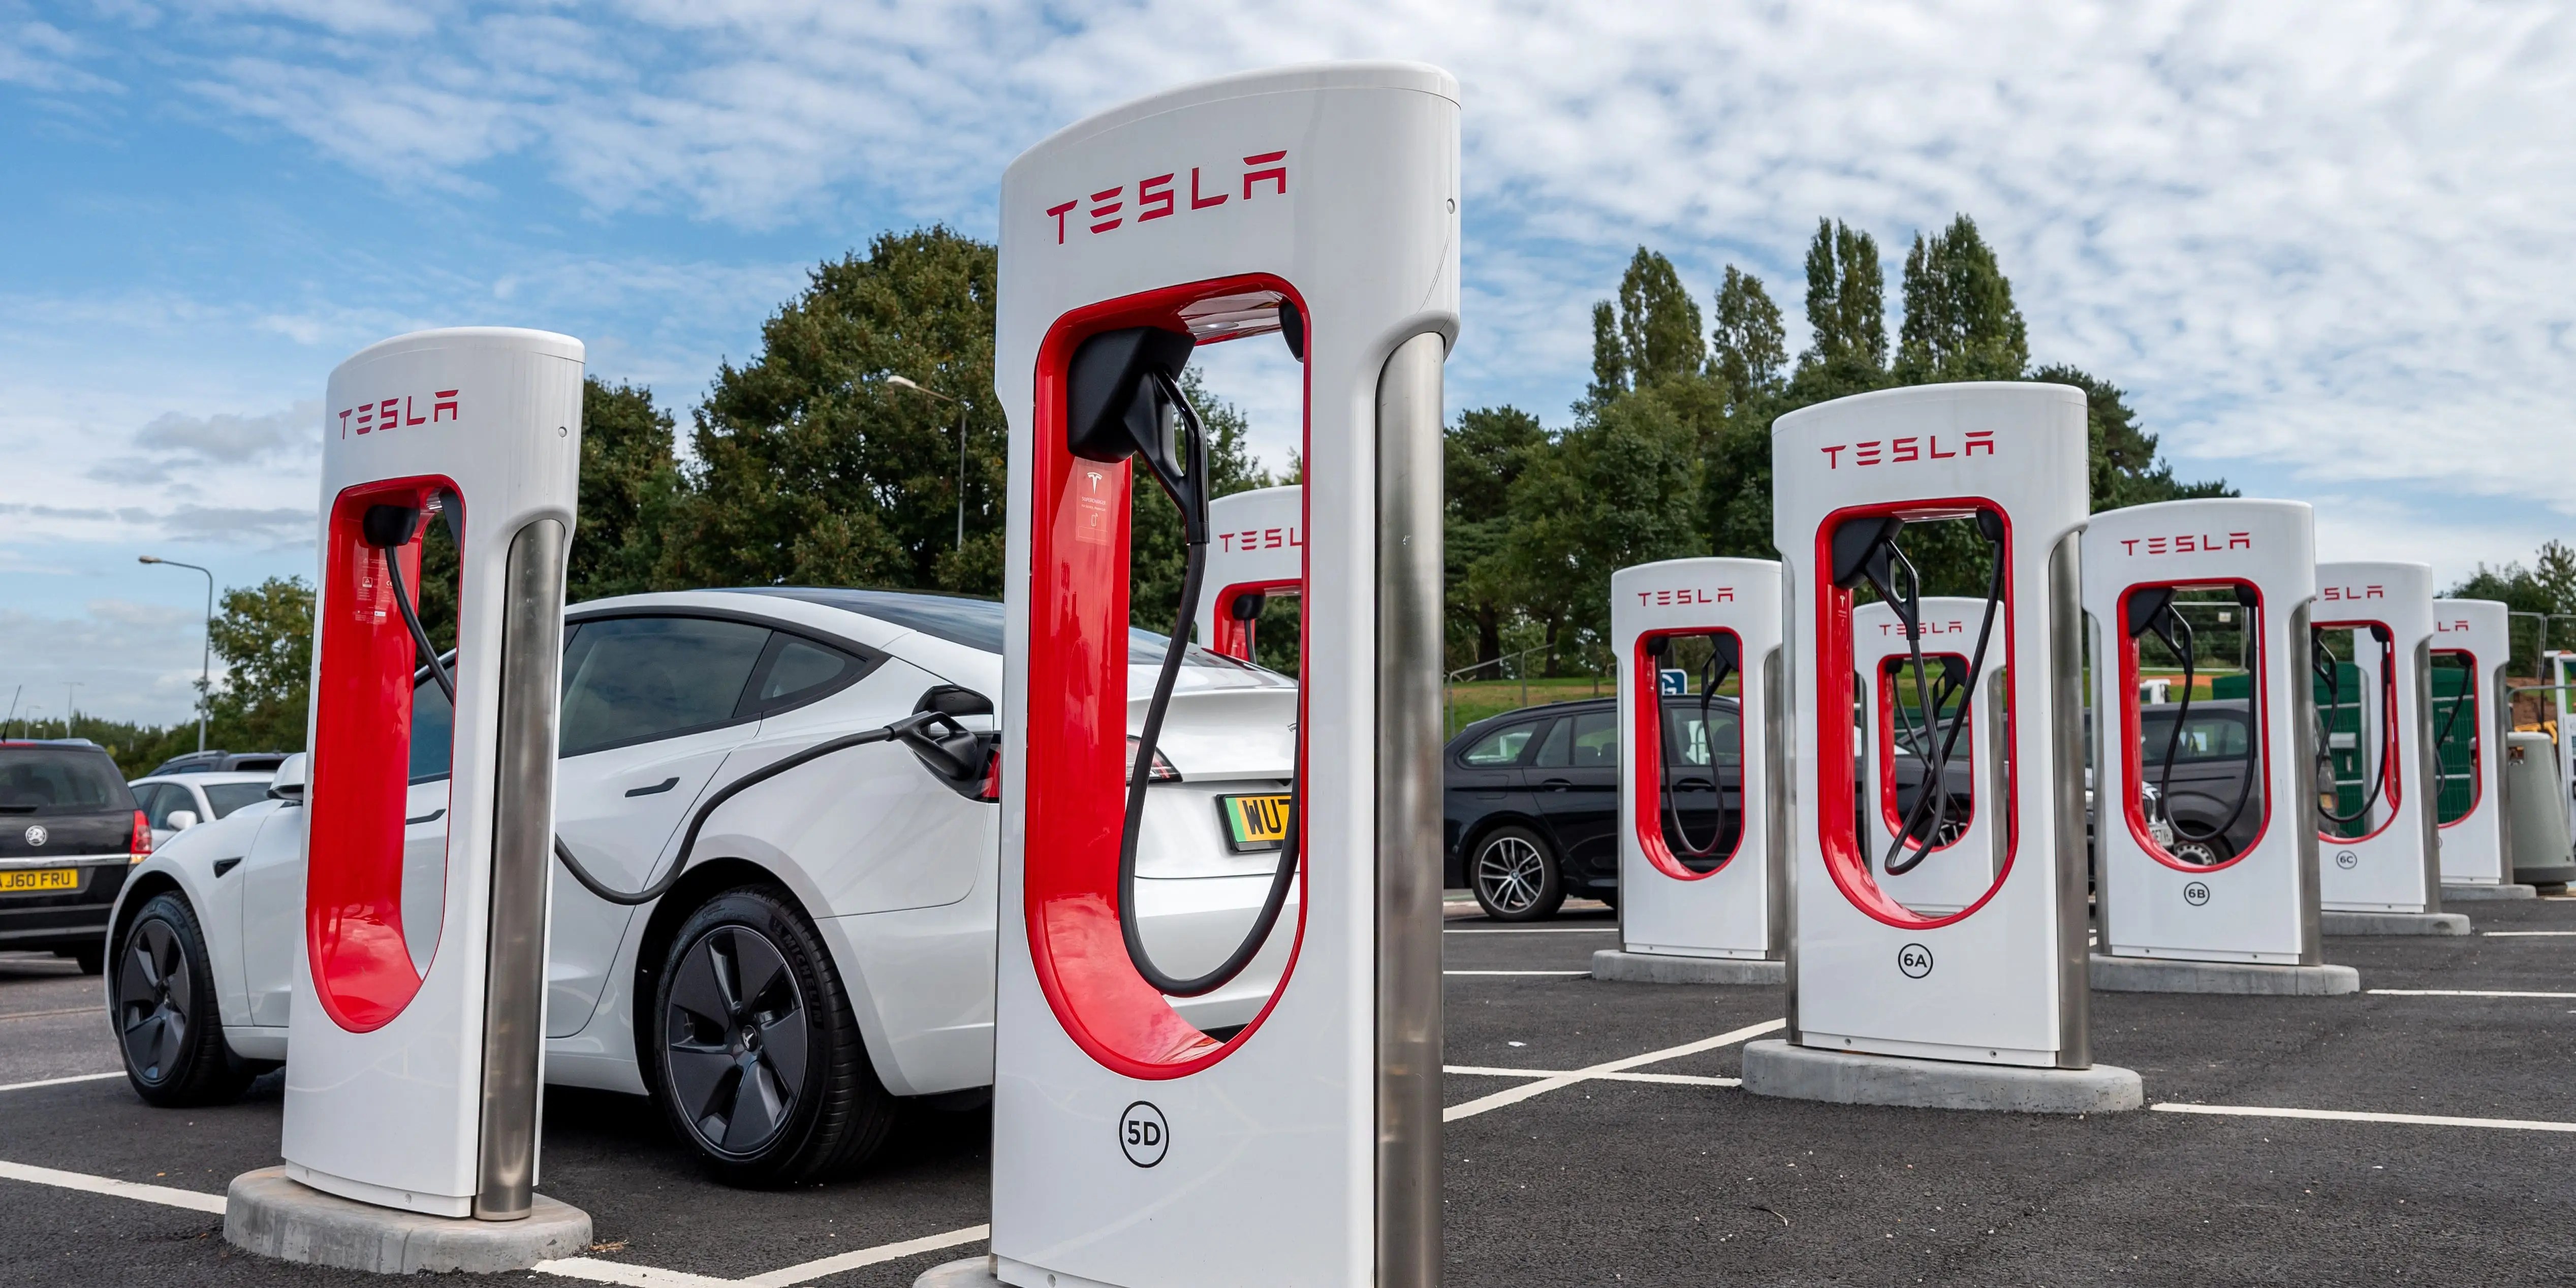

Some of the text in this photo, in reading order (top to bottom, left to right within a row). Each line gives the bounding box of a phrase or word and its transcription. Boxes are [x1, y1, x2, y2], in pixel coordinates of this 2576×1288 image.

[1046, 150, 1287, 245] TESLA
[339, 389, 459, 439] TESLA
[1821, 430, 1994, 469] TESLA
[1219, 527, 1302, 553] TESL
[2121, 532, 2250, 556] TESLA
[1638, 587, 1734, 607] TESLA
[2324, 585, 2383, 601] SLA
[40, 872, 70, 886] FRU
[2188, 889, 2206, 898] 6B
[1904, 953, 1928, 968] 6A
[783, 933, 822, 1023] MICHELIN
[1127, 1120, 1161, 1146] 5D
